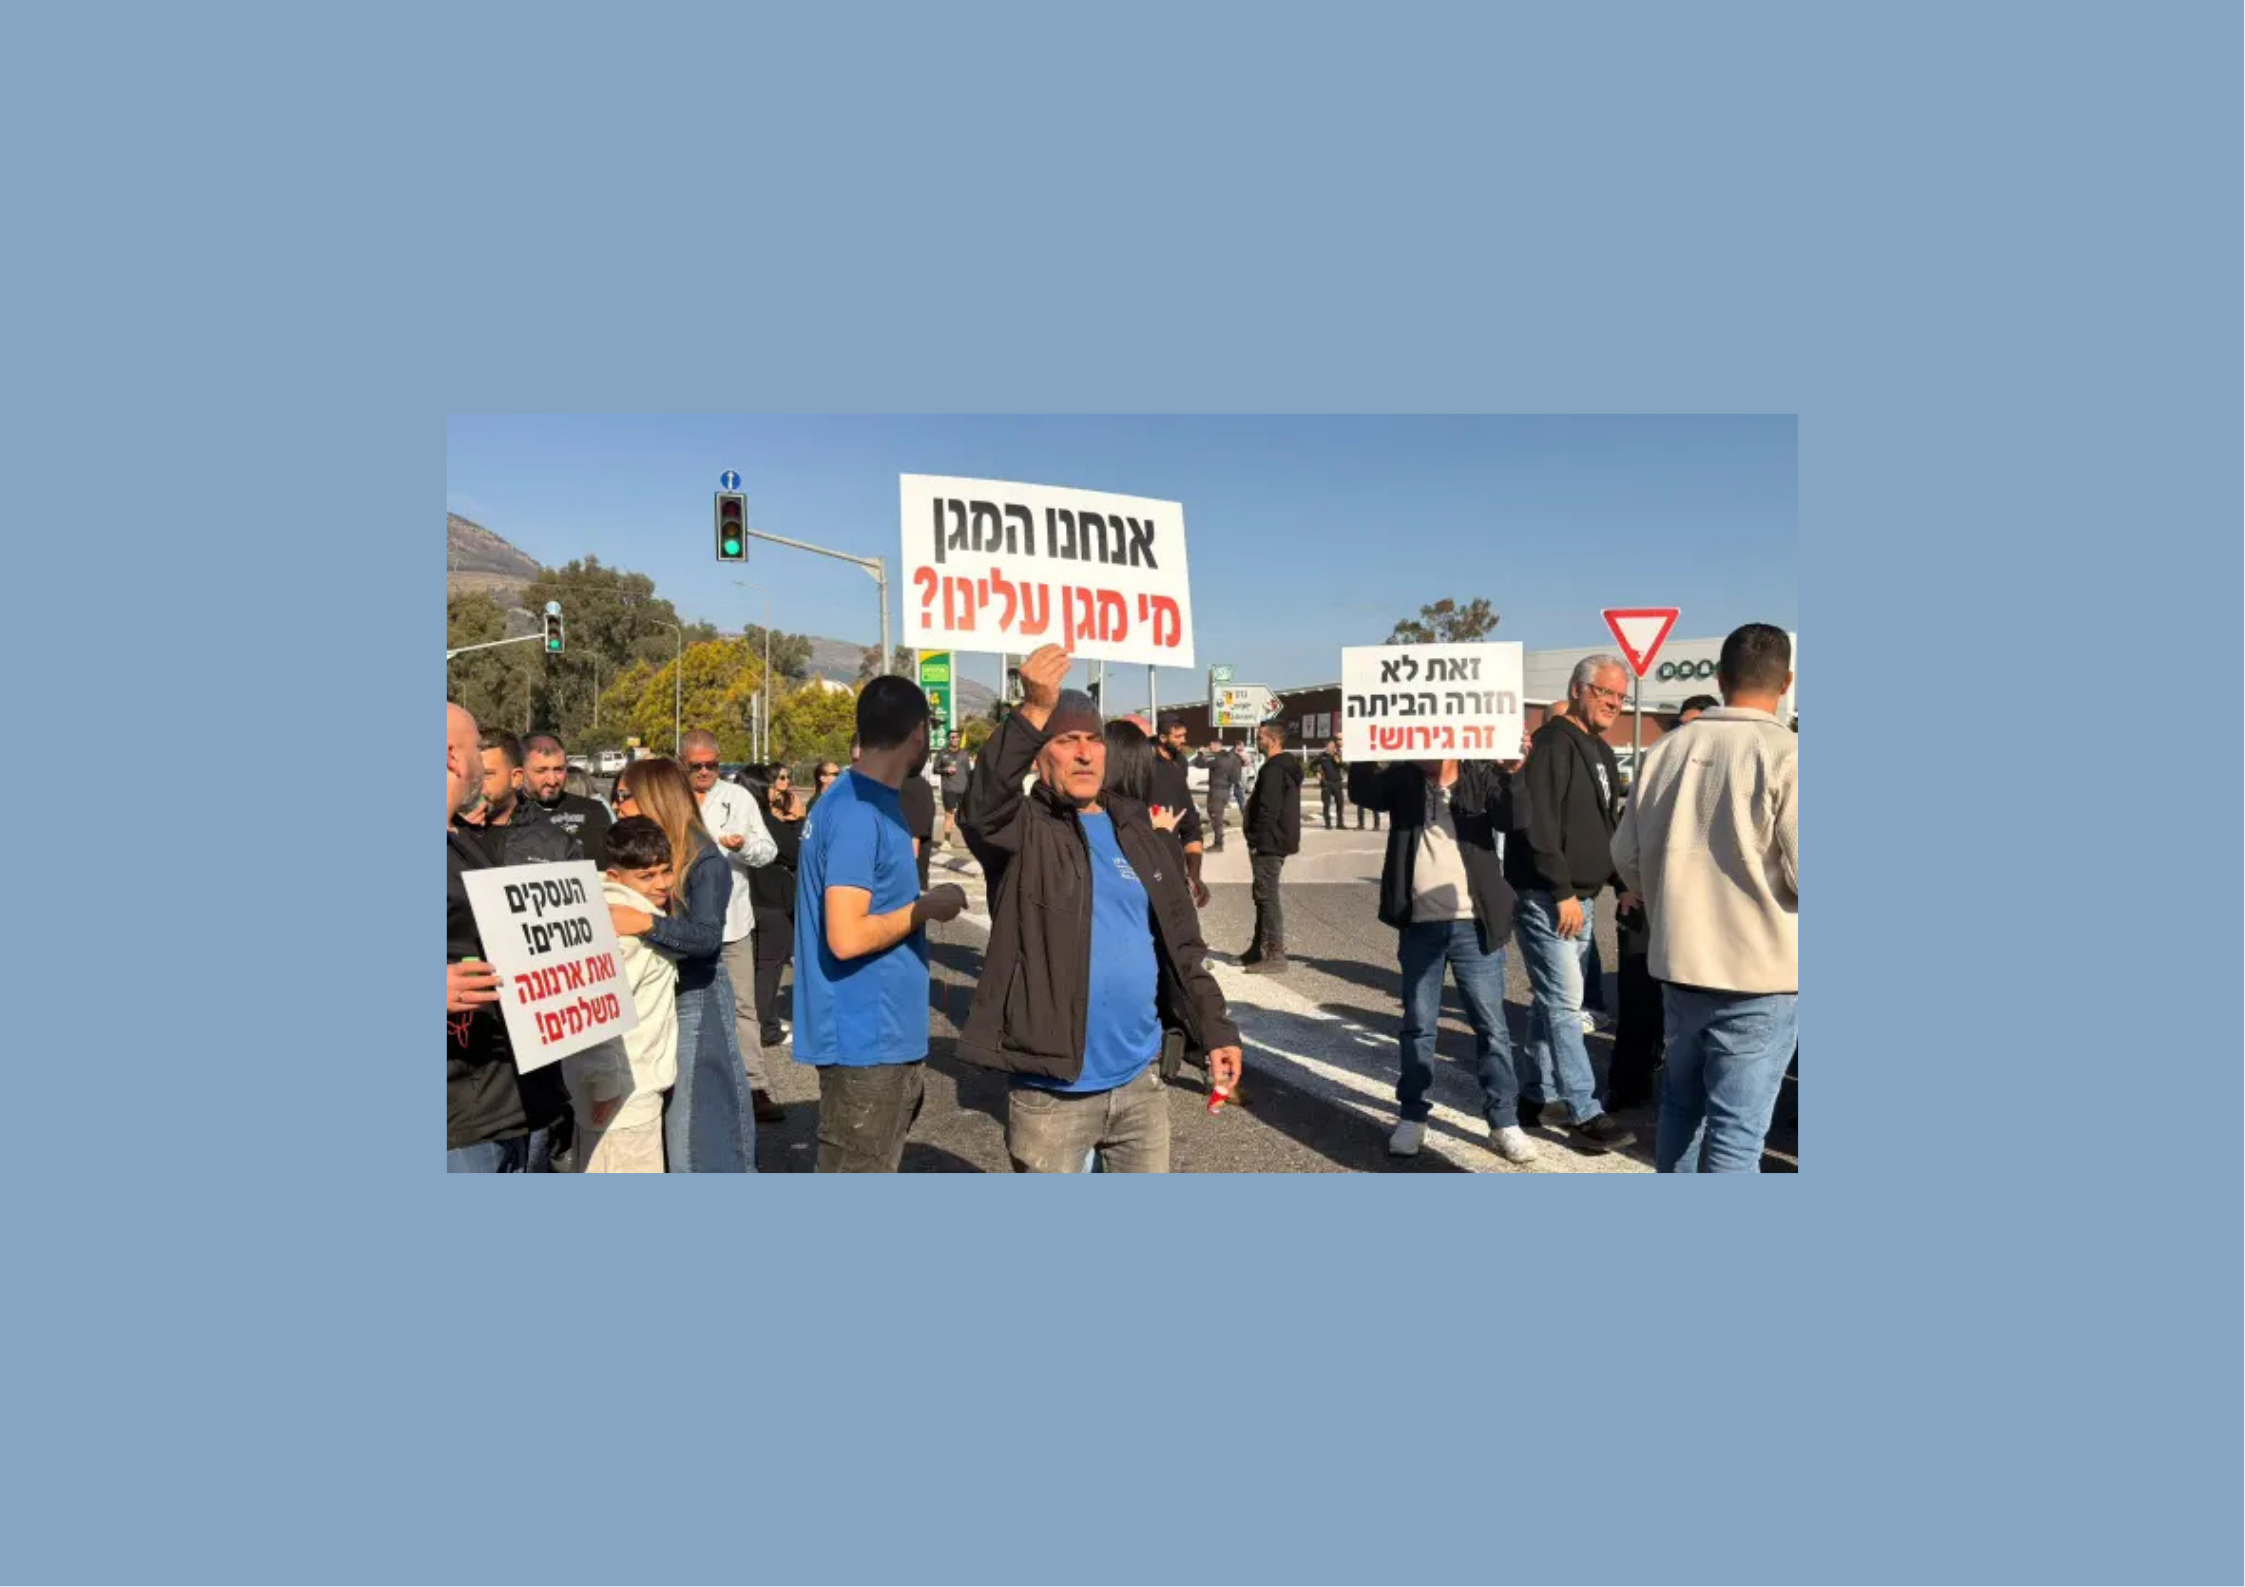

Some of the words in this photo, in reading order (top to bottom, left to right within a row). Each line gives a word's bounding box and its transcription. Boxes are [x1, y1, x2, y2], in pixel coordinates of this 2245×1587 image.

[933, 497, 1035, 564] המגן
[1045, 506, 1158, 570] אנחנו
[913, 565, 1050, 635] עלינו?
[1062, 584, 1128, 653] מגן
[1138, 593, 1182, 648] מי
[1381, 654, 1418, 683] לא
[1425, 658, 1481, 682] זאת
[1347, 692, 1437, 718] הביתה
[1445, 691, 1517, 714] חזרה
[1370, 724, 1455, 750] גירוש!
[1462, 725, 1495, 749] זה
[504, 877, 587, 917] העסקים
[521, 917, 593, 955] סגורים!
[514, 960, 585, 1004] ארנונה
[585, 953, 616, 984] ואת
[535, 993, 620, 1044] משלמים!
